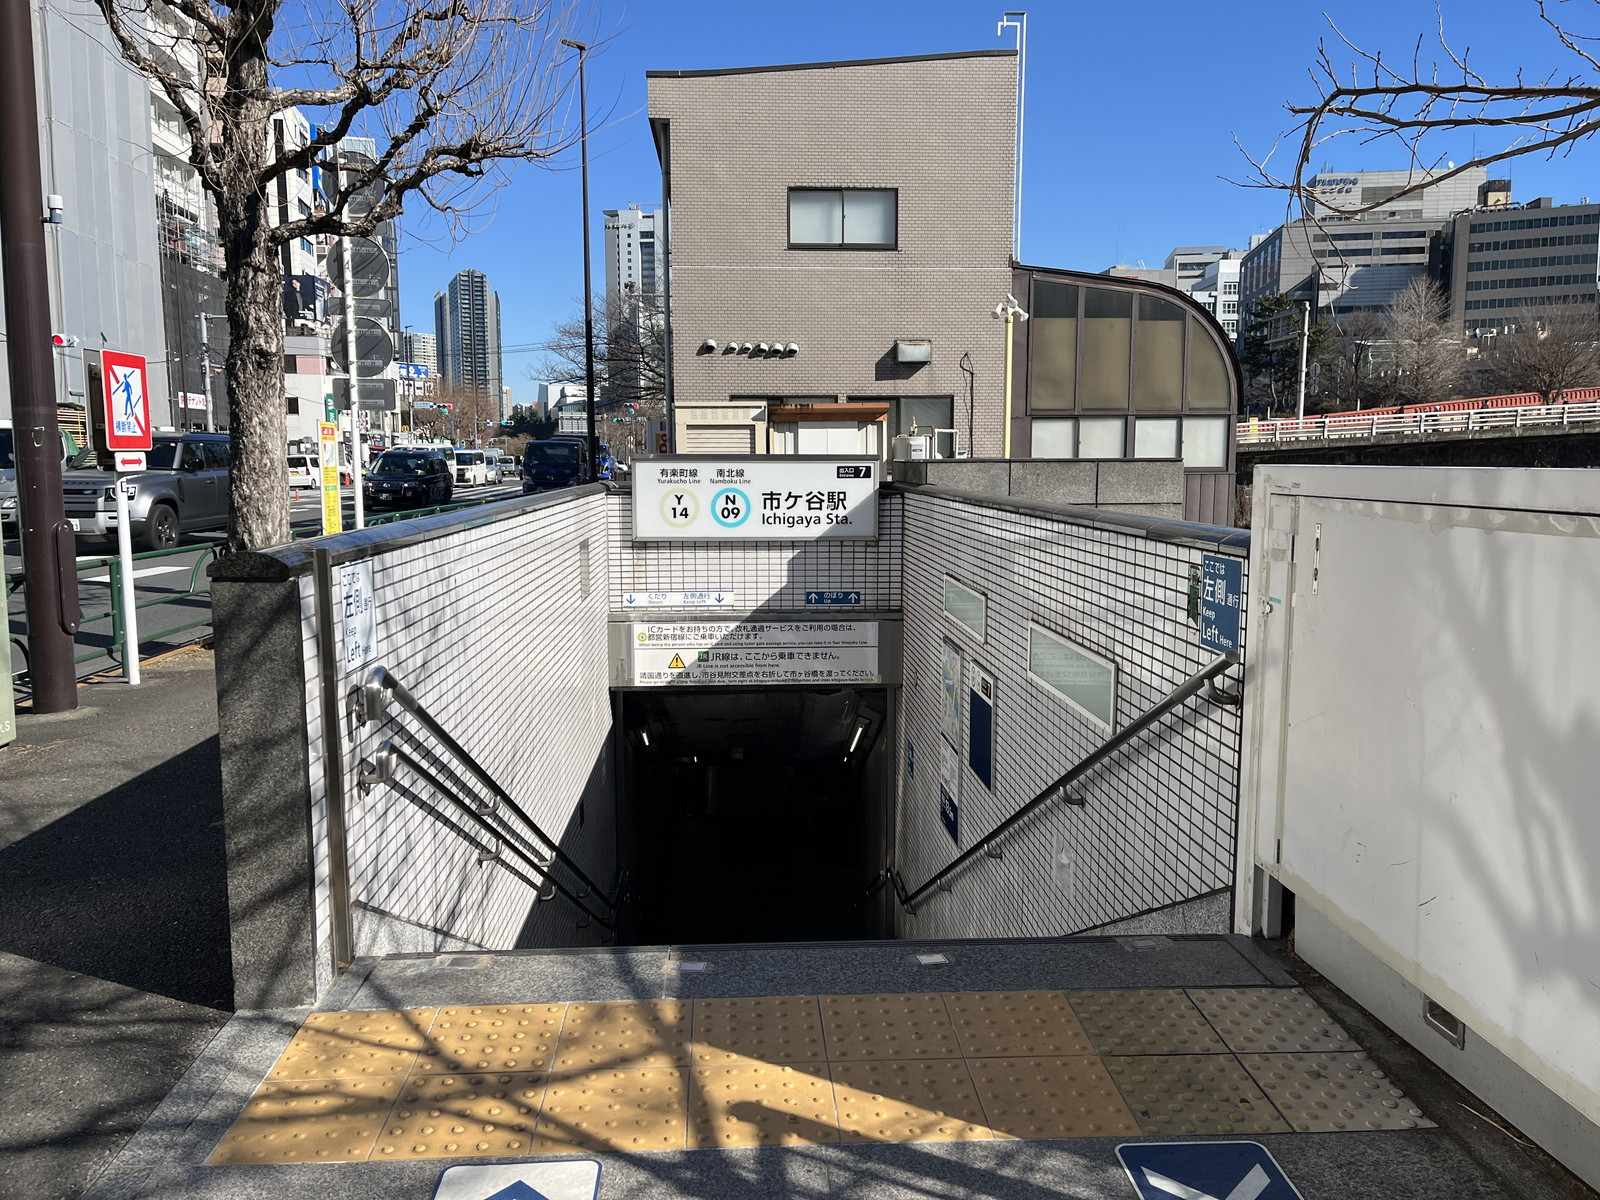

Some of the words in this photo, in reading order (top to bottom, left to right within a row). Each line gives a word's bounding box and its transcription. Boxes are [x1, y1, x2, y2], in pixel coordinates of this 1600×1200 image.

[660, 468, 698, 478] 有楽町線
[716, 468, 744, 478] 南北線
[859, 467, 866, 477] 7
[674, 495, 684, 505] Y
[725, 495, 736, 505] N
[672, 508, 689, 518] 14
[721, 507, 740, 518] 09
[762, 513, 820, 528] Ichigaya
[826, 513, 853, 524] Sta.
[1205, 560, 1225, 575] ここでは
[342, 572, 360, 586] ここでは
[1203, 606, 1216, 621] Keep
[346, 626, 356, 638] Keep
[1202, 622, 1219, 644] Left
[1219, 634, 1232, 648] Here
[346, 640, 361, 663] Left
[711, 652, 840, 661] JR線は、ここから乗車できません。
